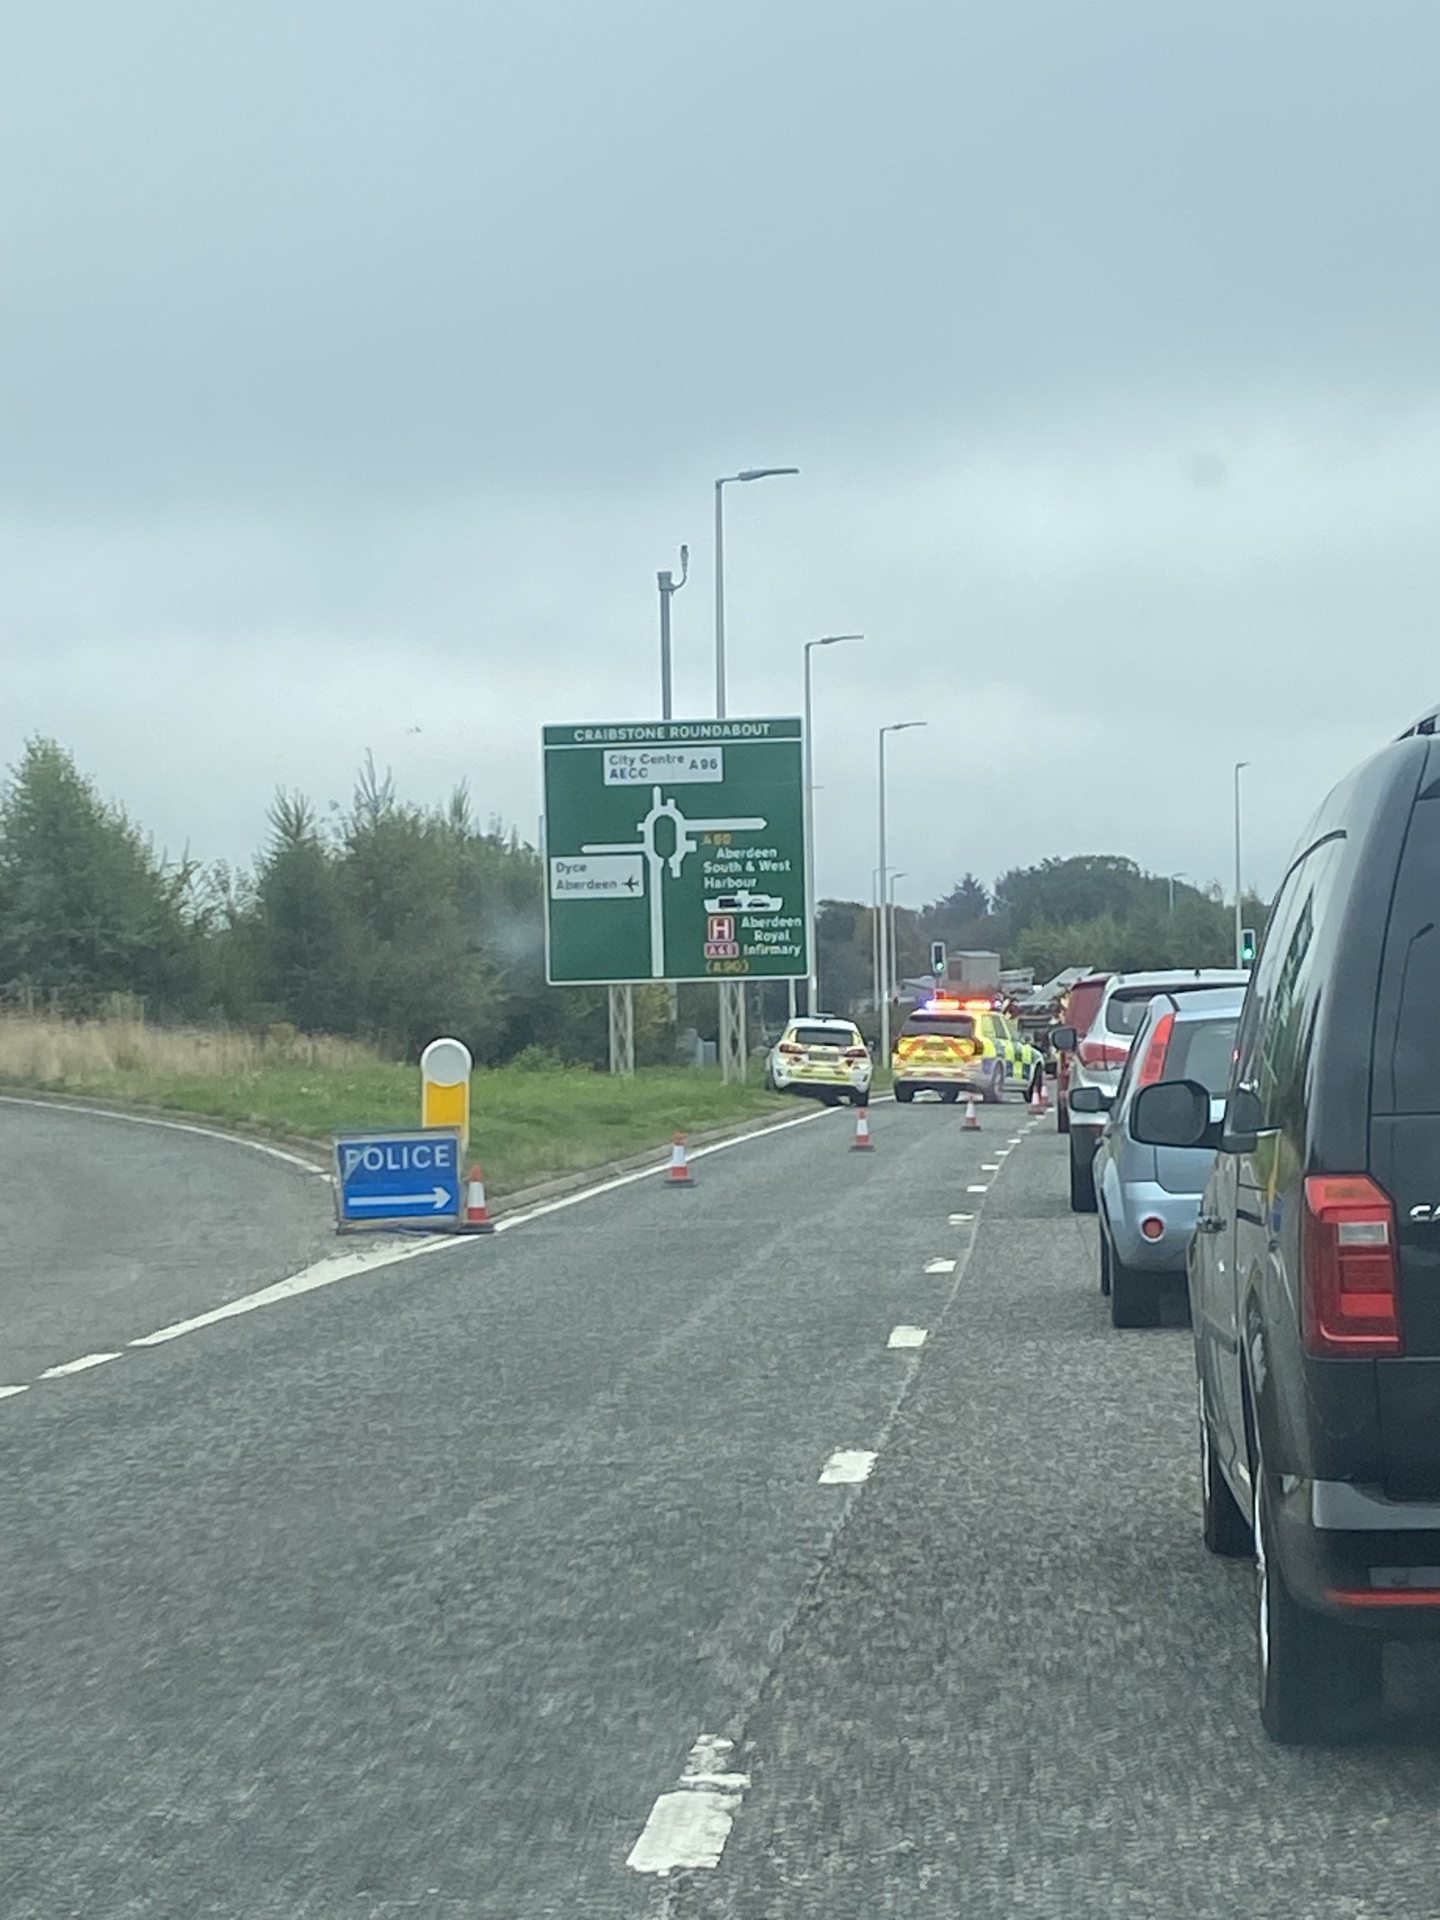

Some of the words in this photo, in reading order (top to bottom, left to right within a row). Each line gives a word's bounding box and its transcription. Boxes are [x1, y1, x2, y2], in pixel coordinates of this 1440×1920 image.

[574, 727, 665, 742] CRAIBSTONE
[670, 723, 771, 738] ROUNDABOUT
[609, 754, 636, 767] City
[640, 753, 685, 765] Centre
[689, 758, 718, 770] A96
[609, 767, 649, 779] AECC
[716, 847, 777, 859] Aberdeen
[556, 862, 587, 875] Dyce
[703, 861, 742, 873] South
[745, 860, 755, 872] &
[759, 859, 791, 872] West
[556, 879, 618, 890] Aberdeen
[704, 876, 757, 888] Harbour
[741, 916, 802, 928] Aberdeen
[754, 929, 790, 943] Royal
[743, 944, 802, 957] Infirmary
[345, 1146, 450, 1170] POLICE
